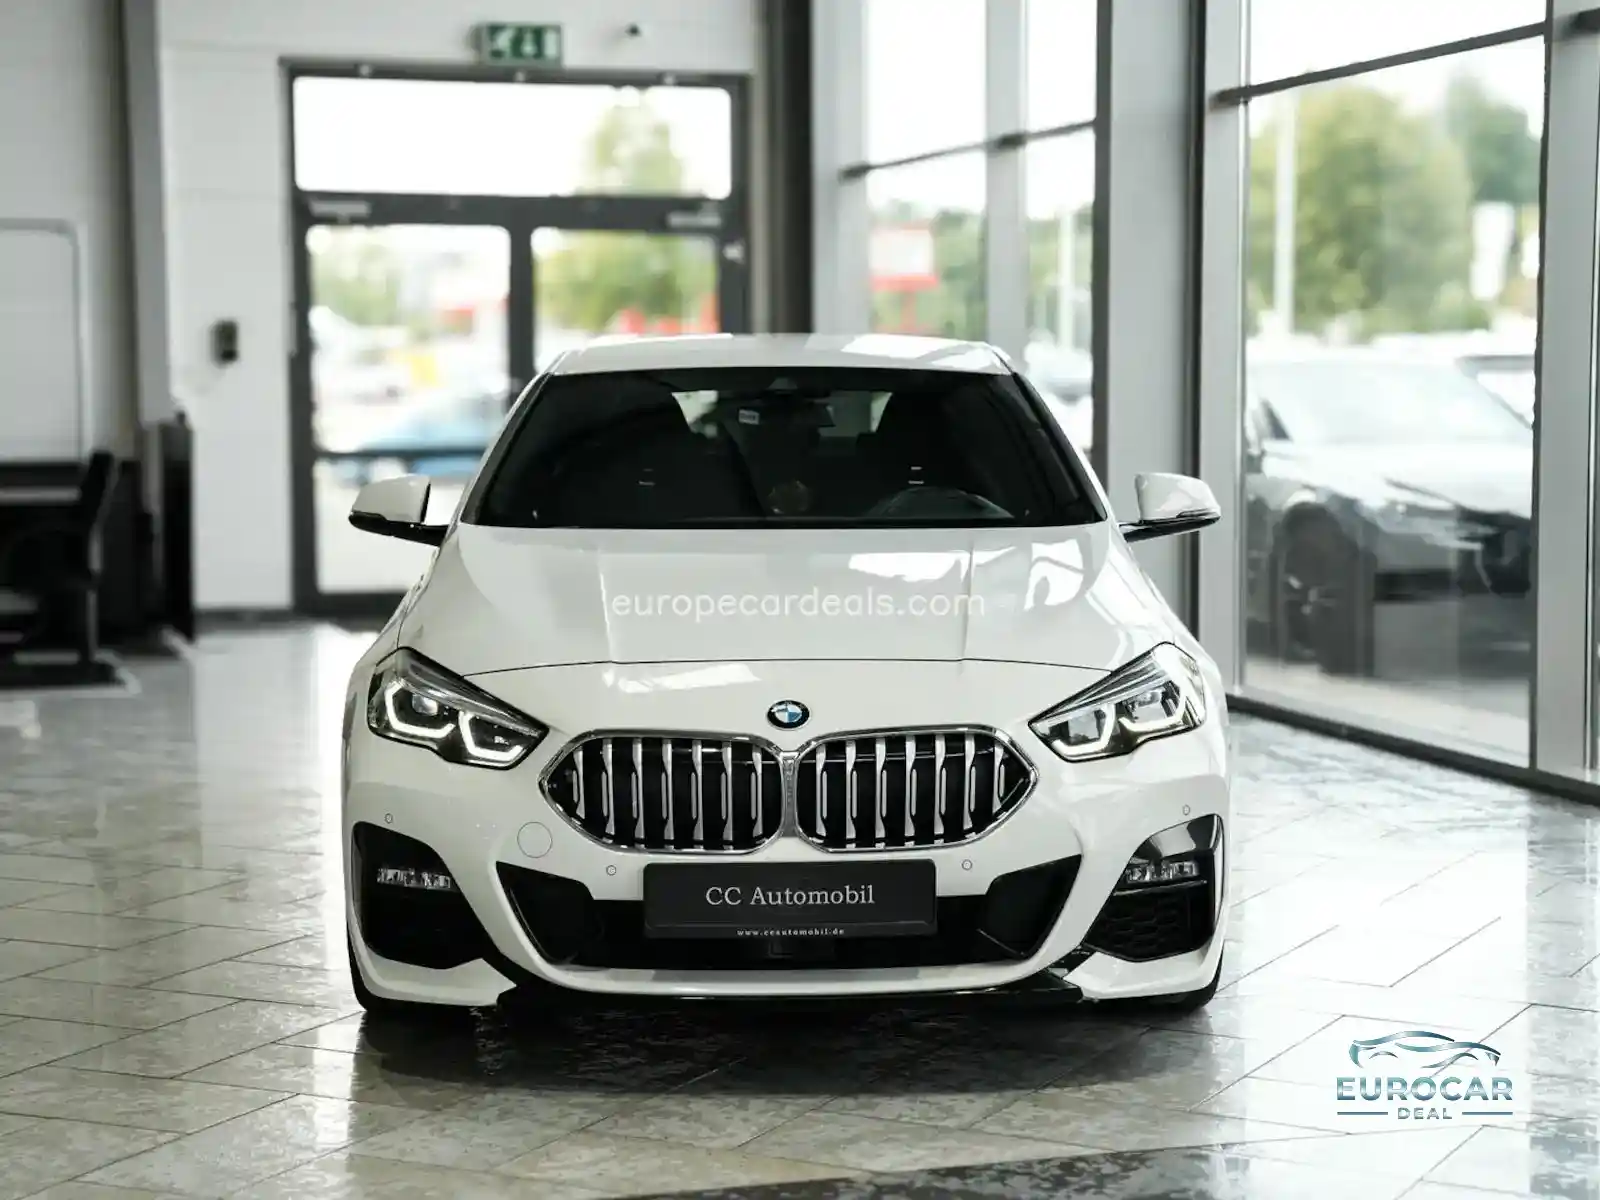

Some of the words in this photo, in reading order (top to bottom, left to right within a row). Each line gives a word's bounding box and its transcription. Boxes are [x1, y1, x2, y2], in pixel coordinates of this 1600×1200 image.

[705, 886, 741, 905] CC
[750, 885, 875, 905] Automobil
[737, 927, 844, 936] www.ccautomobil.de
